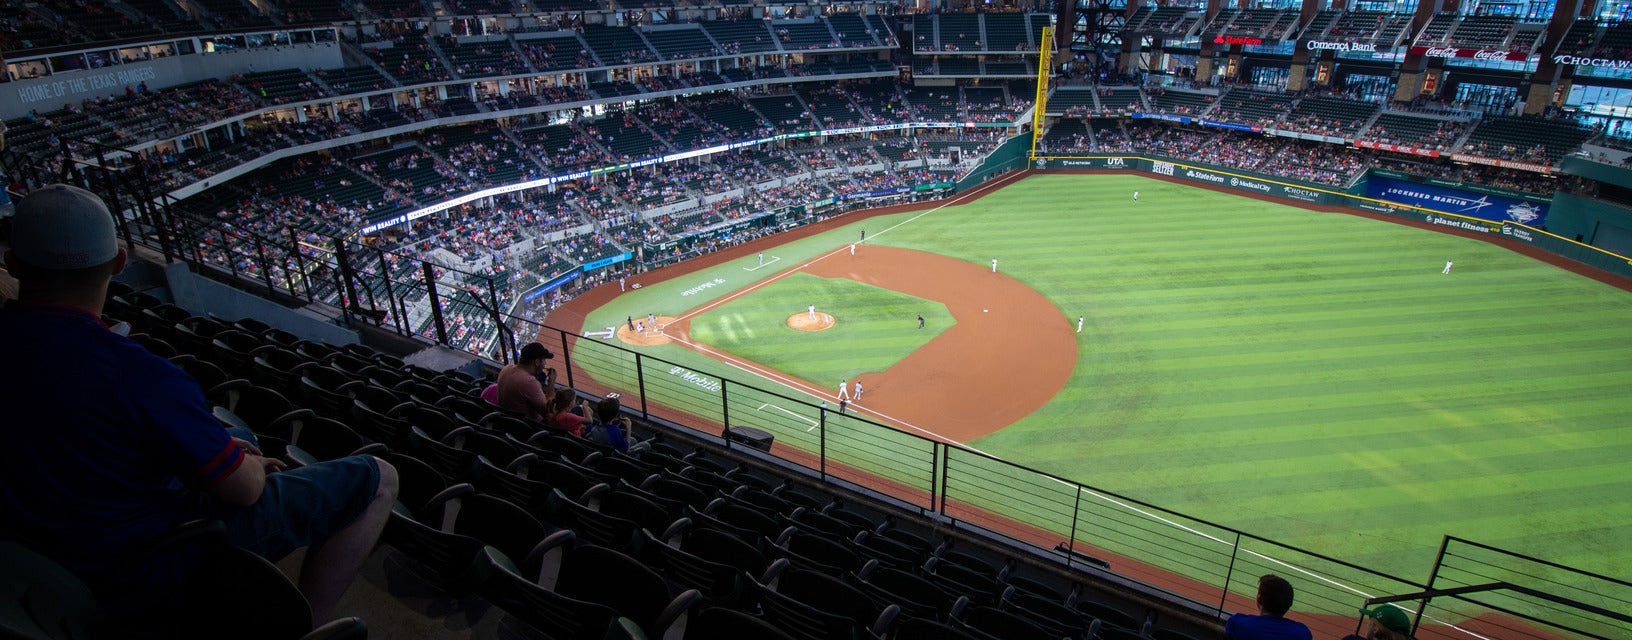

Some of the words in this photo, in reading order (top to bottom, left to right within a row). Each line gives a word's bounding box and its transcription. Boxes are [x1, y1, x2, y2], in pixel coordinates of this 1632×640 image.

[1351, 42, 1377, 52] Bank
[18, 84, 52, 103] HOME
[53, 80, 65, 97] OF
[68, 78, 88, 94] THE
[89, 73, 118, 90] TEXAS
[119, 67, 155, 84] RANGERS
[641, 158, 658, 166] REALITY
[1107, 157, 1124, 165] UTA
[1453, 154, 1497, 166] WHATABURGER
[1500, 160, 1547, 172] WHATABURGER
[569, 171, 589, 180] REALITY
[1152, 164, 1174, 176] SELTZER
[1286, 186, 1319, 198] CHOCTAW
[1388, 187, 1430, 200] LOCKHEED
[1433, 195, 1467, 206] MARTIN
[362, 225, 377, 235] WIN
[377, 217, 400, 230] REALITY
[1433, 217, 1460, 228] planet
[1461, 222, 1490, 233] fitness
[681, 369, 721, 392] Mobile
